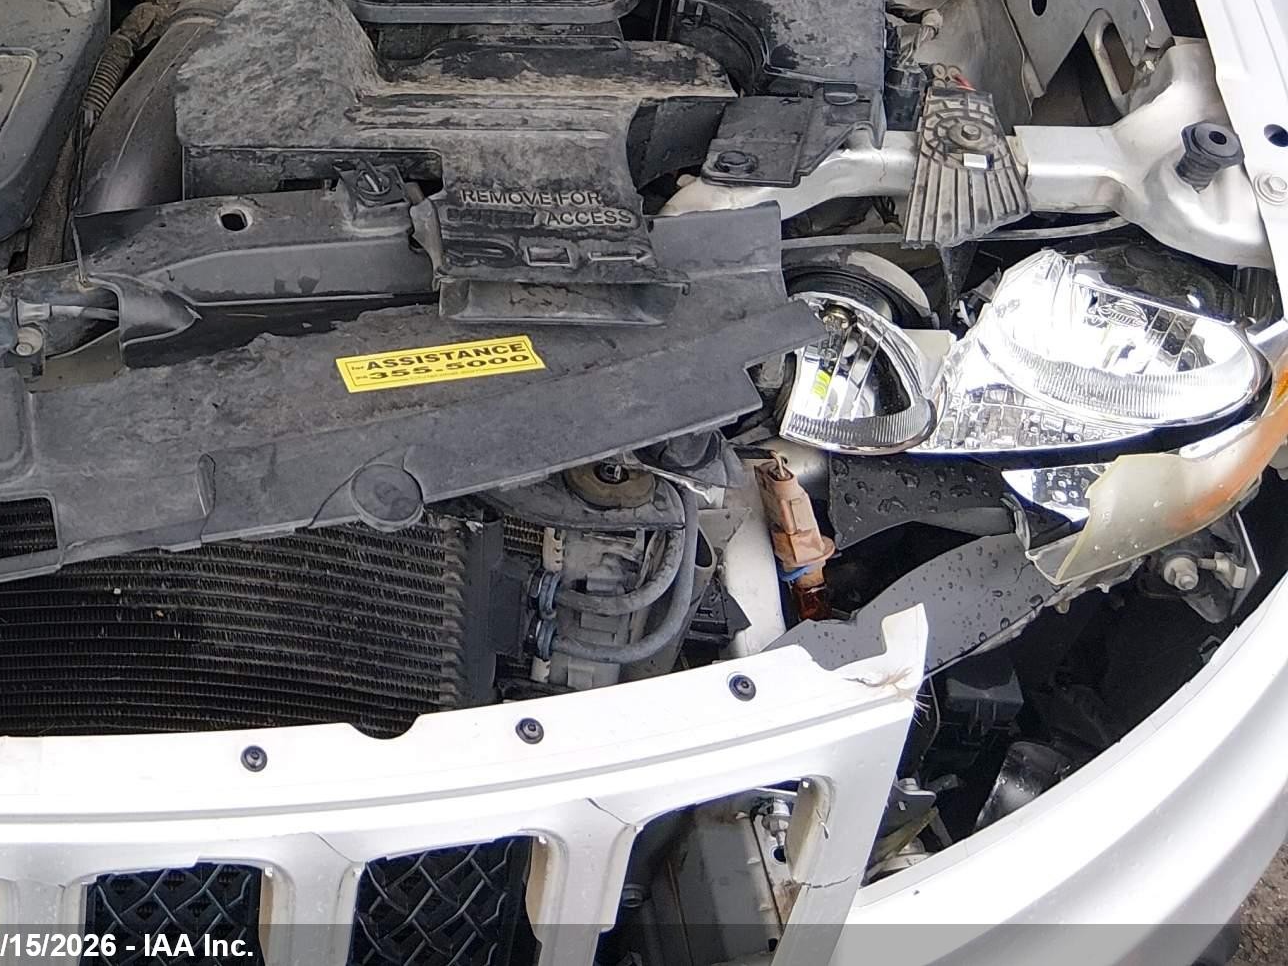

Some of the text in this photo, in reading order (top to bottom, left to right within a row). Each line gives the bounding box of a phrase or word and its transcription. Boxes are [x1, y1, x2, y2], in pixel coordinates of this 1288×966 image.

[461, 190, 603, 206] REMOVE FOR
[546, 210, 632, 226] ACCESS
[366, 343, 526, 371] ASSISTANCE
[369, 354, 530, 380] 355-5000
